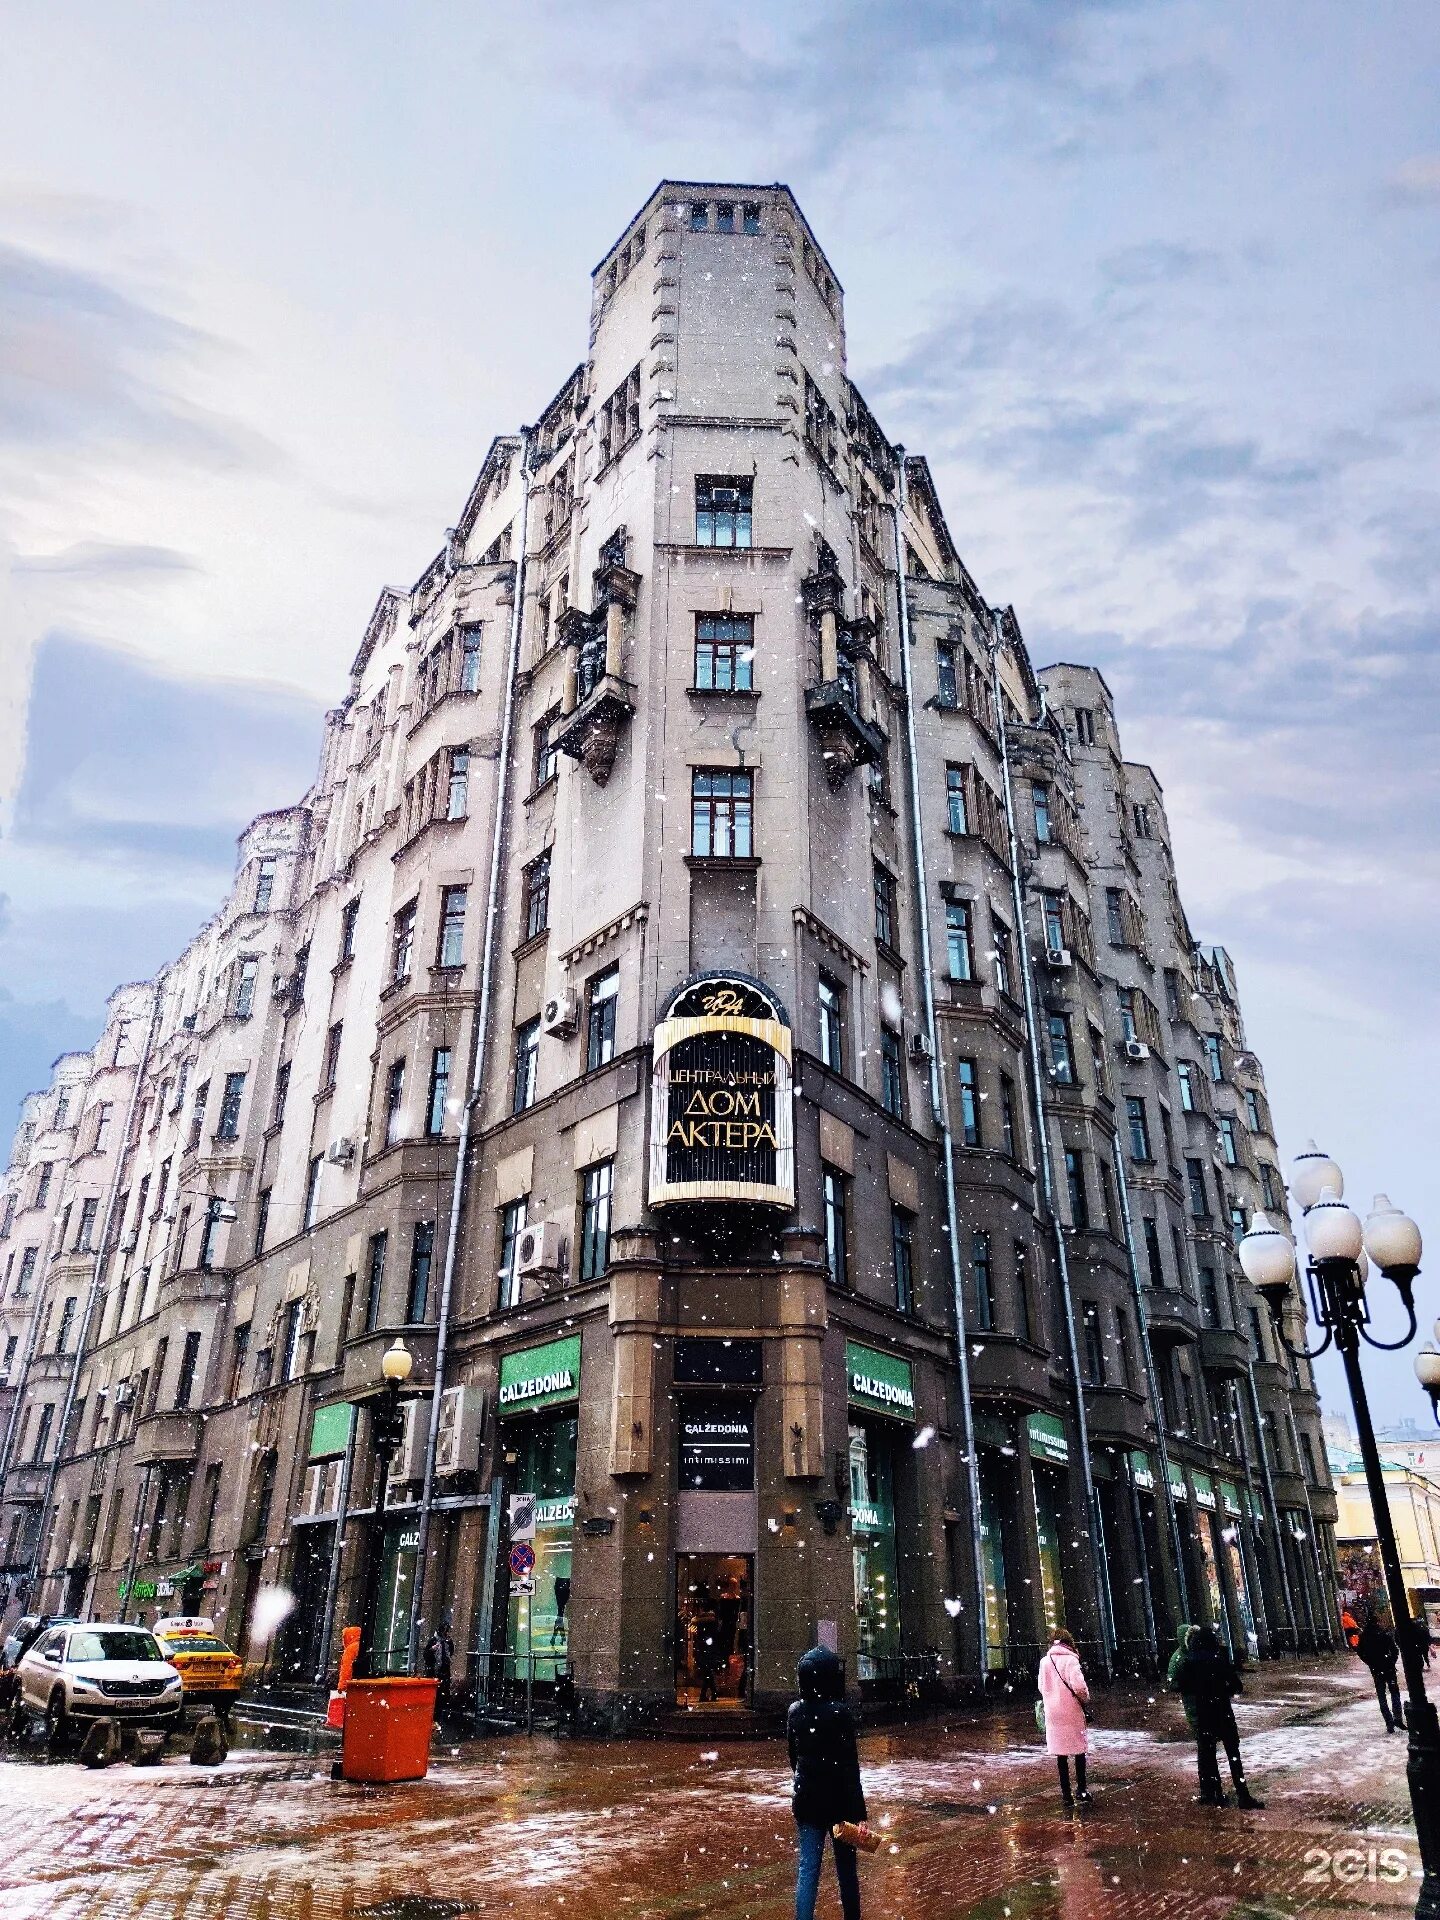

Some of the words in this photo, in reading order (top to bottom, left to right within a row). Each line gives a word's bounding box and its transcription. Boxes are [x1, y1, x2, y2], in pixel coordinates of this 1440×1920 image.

[669, 1069, 776, 1085] ЦЕНТРАЛЬНЫЙ
[684, 1089, 760, 1116] ДОМ
[667, 1120, 779, 1148] АКТЕРА
[500, 1370, 571, 1403] CALZEDONIA
[854, 1373, 914, 1407] CALZEDONIA
[685, 1424, 748, 1433] CALZEDONIA
[684, 1456, 749, 1464] intimissimi
